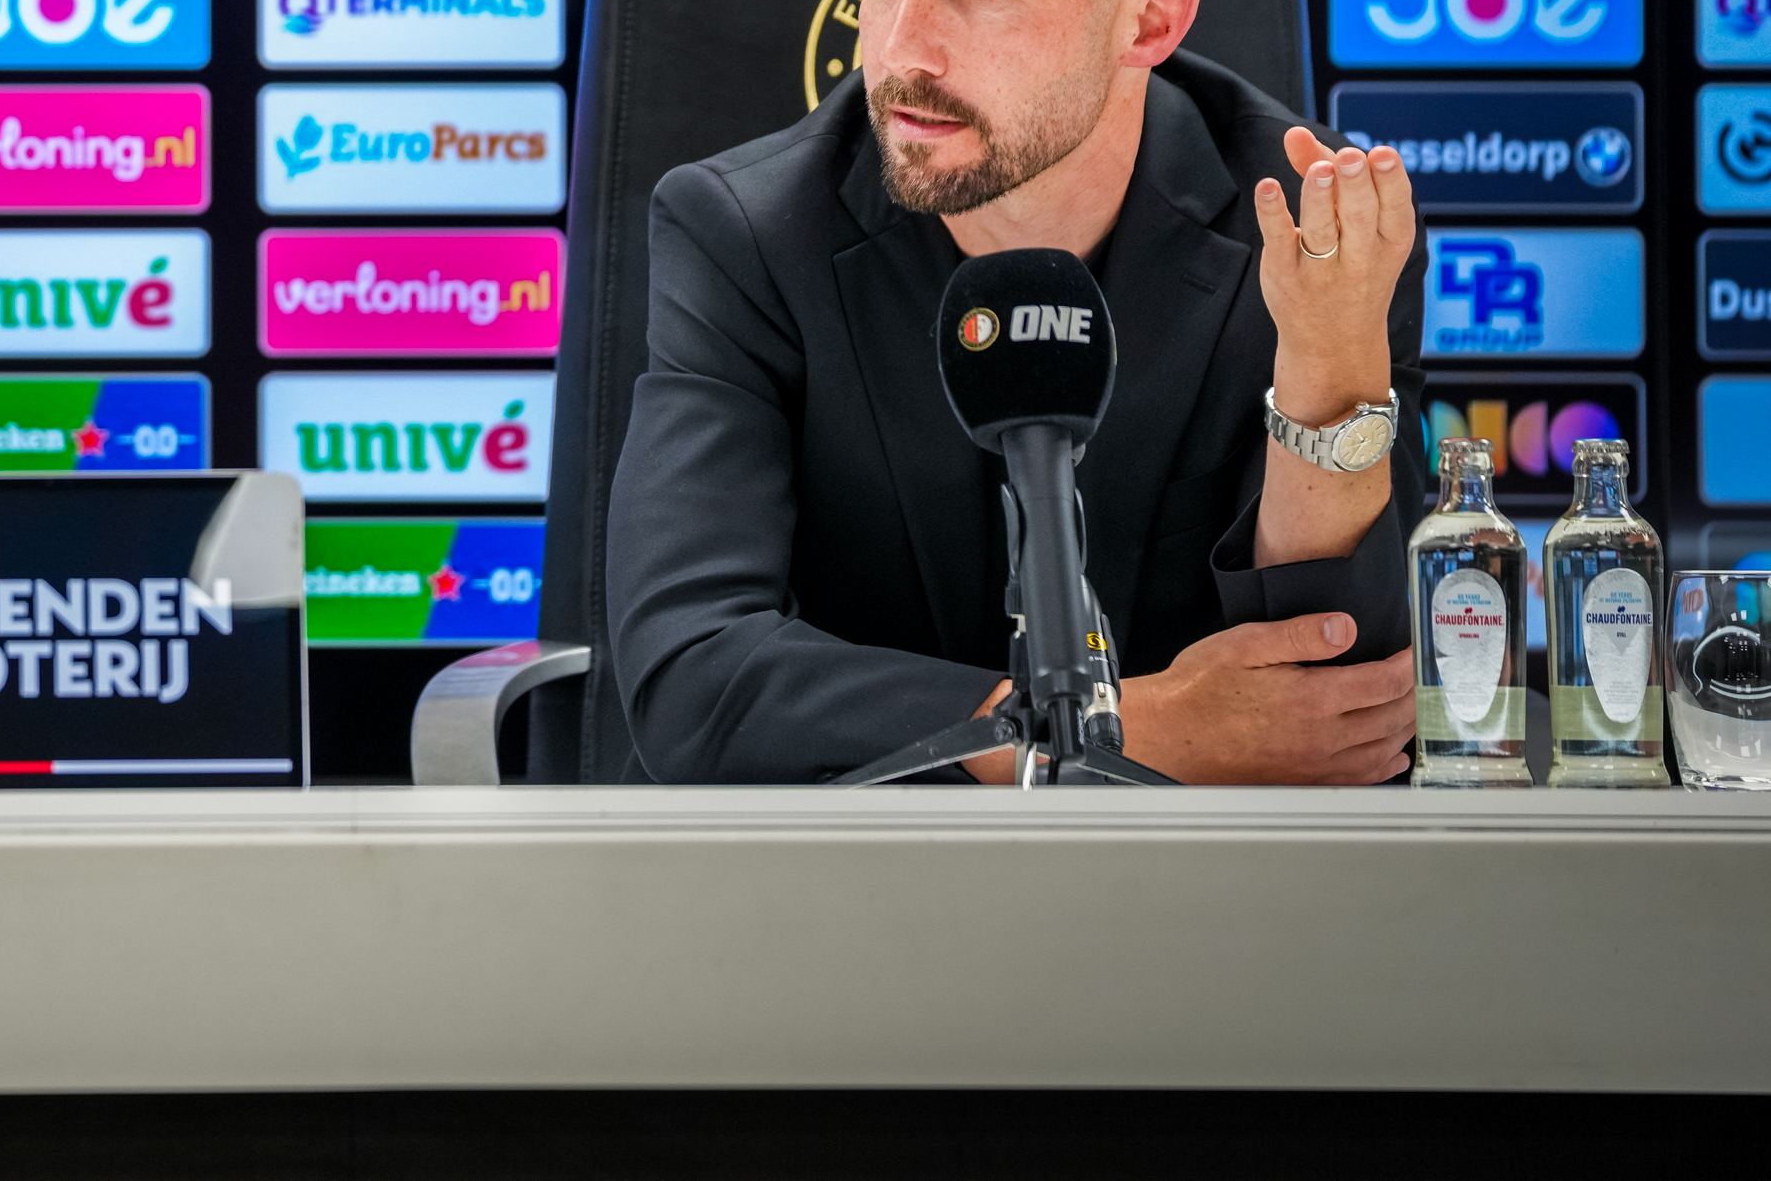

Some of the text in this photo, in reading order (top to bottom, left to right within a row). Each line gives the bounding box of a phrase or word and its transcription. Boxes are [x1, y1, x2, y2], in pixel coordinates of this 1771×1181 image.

[329, 121, 547, 164] EuroParcs
[1344, 130, 1572, 182] sseldorp
[274, 260, 551, 325] verloning.nl
[1008, 304, 1094, 344] ONE
[295, 397, 529, 473] univé
[303, 564, 423, 598] eineken
